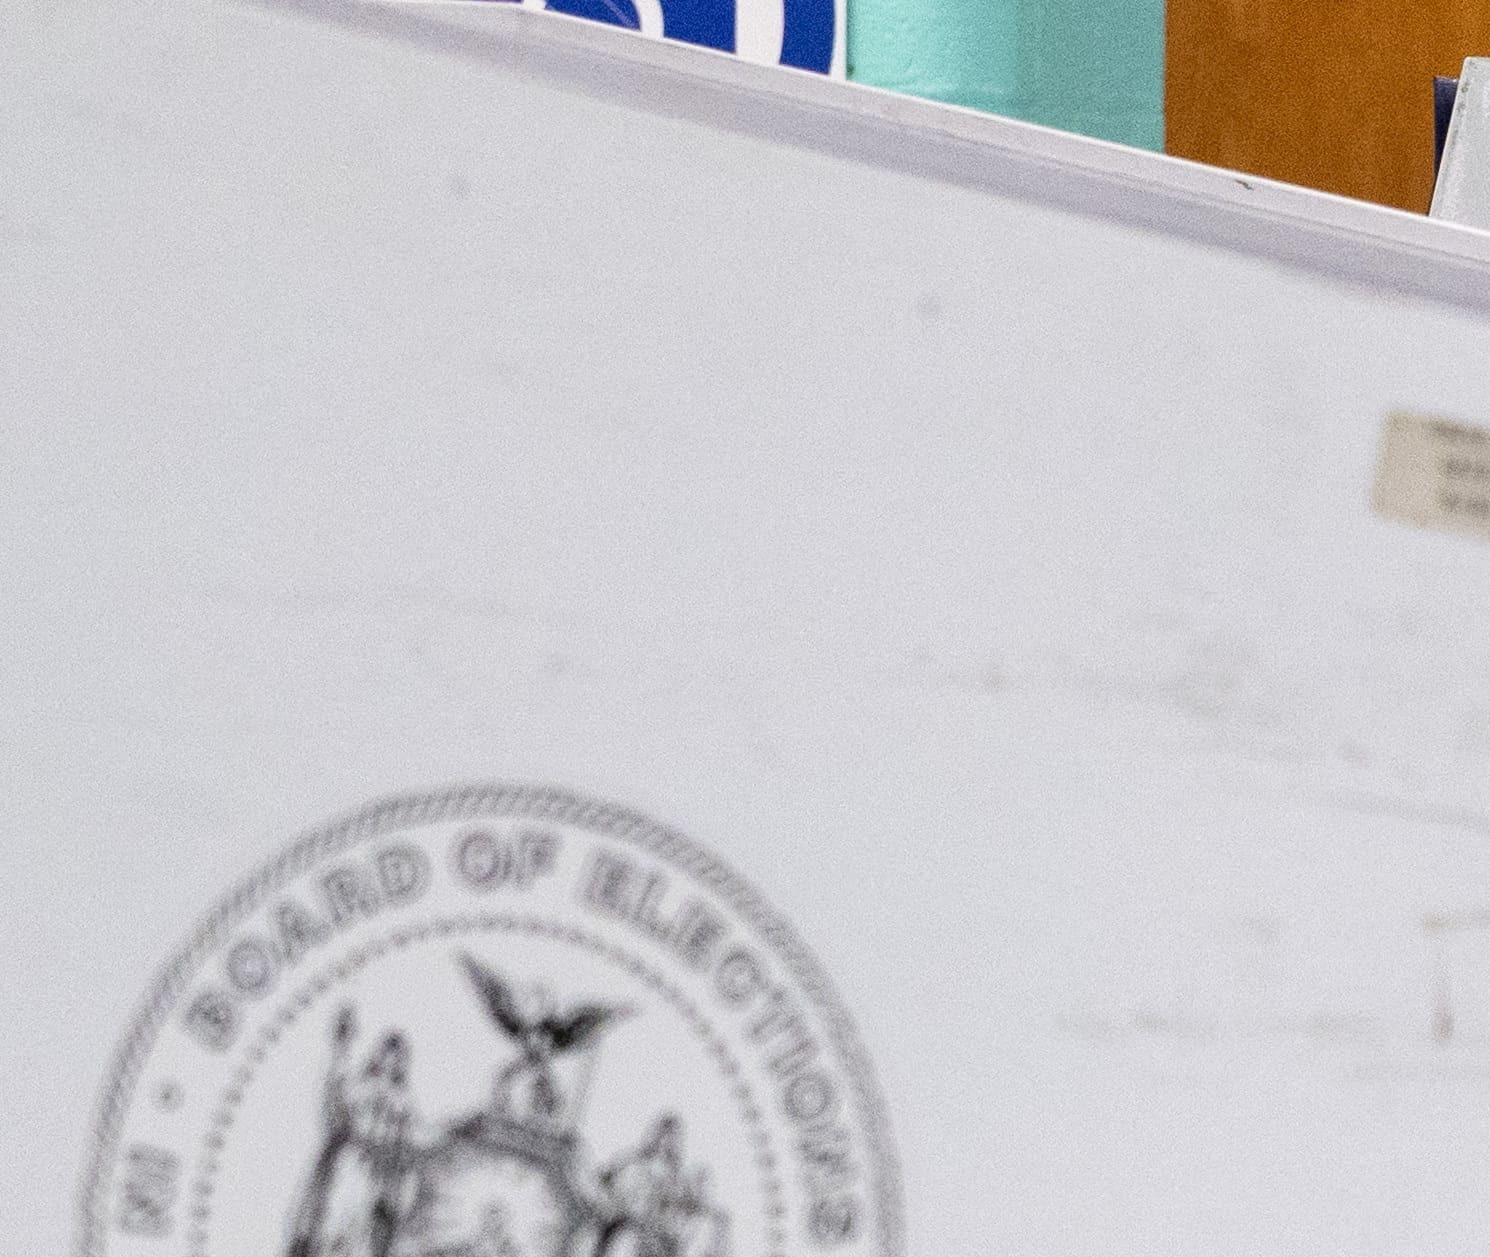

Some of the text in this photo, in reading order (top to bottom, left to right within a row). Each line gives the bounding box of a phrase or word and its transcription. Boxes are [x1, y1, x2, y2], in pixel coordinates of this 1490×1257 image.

[184, 830, 860, 1248] BOARD OF ELECTIONS
[118, 1145, 180, 1237] IN
